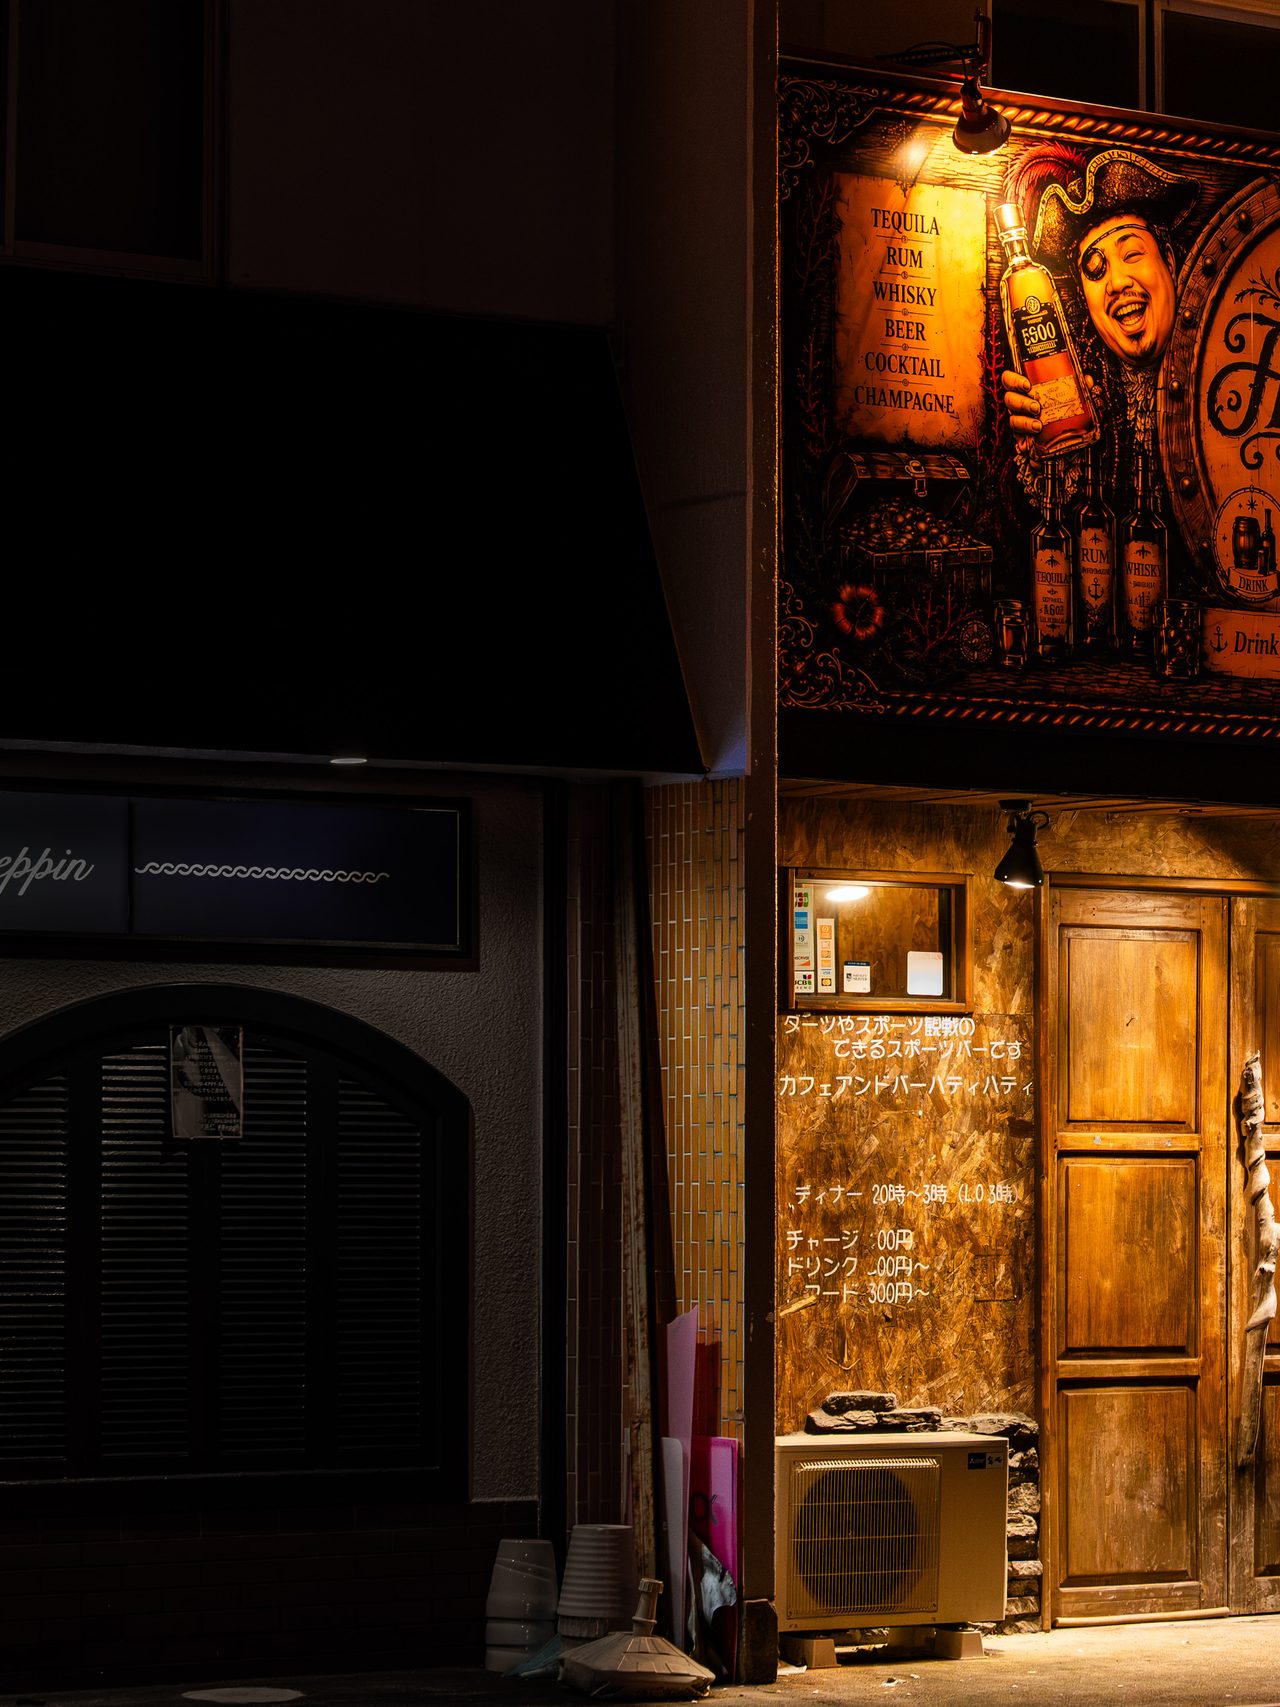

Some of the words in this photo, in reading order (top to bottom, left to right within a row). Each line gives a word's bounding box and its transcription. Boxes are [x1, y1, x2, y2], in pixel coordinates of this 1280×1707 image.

[871, 207, 940, 236] TEQUILA
[886, 246, 923, 269] RUM
[872, 281, 937, 306] WHISKY
[885, 318, 926, 341] BEER
[864, 352, 945, 378] COCKTAIL
[854, 385, 955, 414] CHAMPAGNE
[1081, 547, 1110, 565] RUM
[1036, 571, 1070, 584] TEQUILA
[1124, 561, 1163, 577] WHISKY
[1238, 576, 1269, 592] DRINK
[1233, 630, 1280, 656] Drink
[834, 1039, 1022, 1060] できるスポーツバーです
[779, 1075, 1033, 1097] カフェアンドバーハティハティ
[795, 1185, 863, 1205] ディナー
[787, 1229, 859, 1251] チャージ
[788, 1256, 858, 1277] ドリンク
